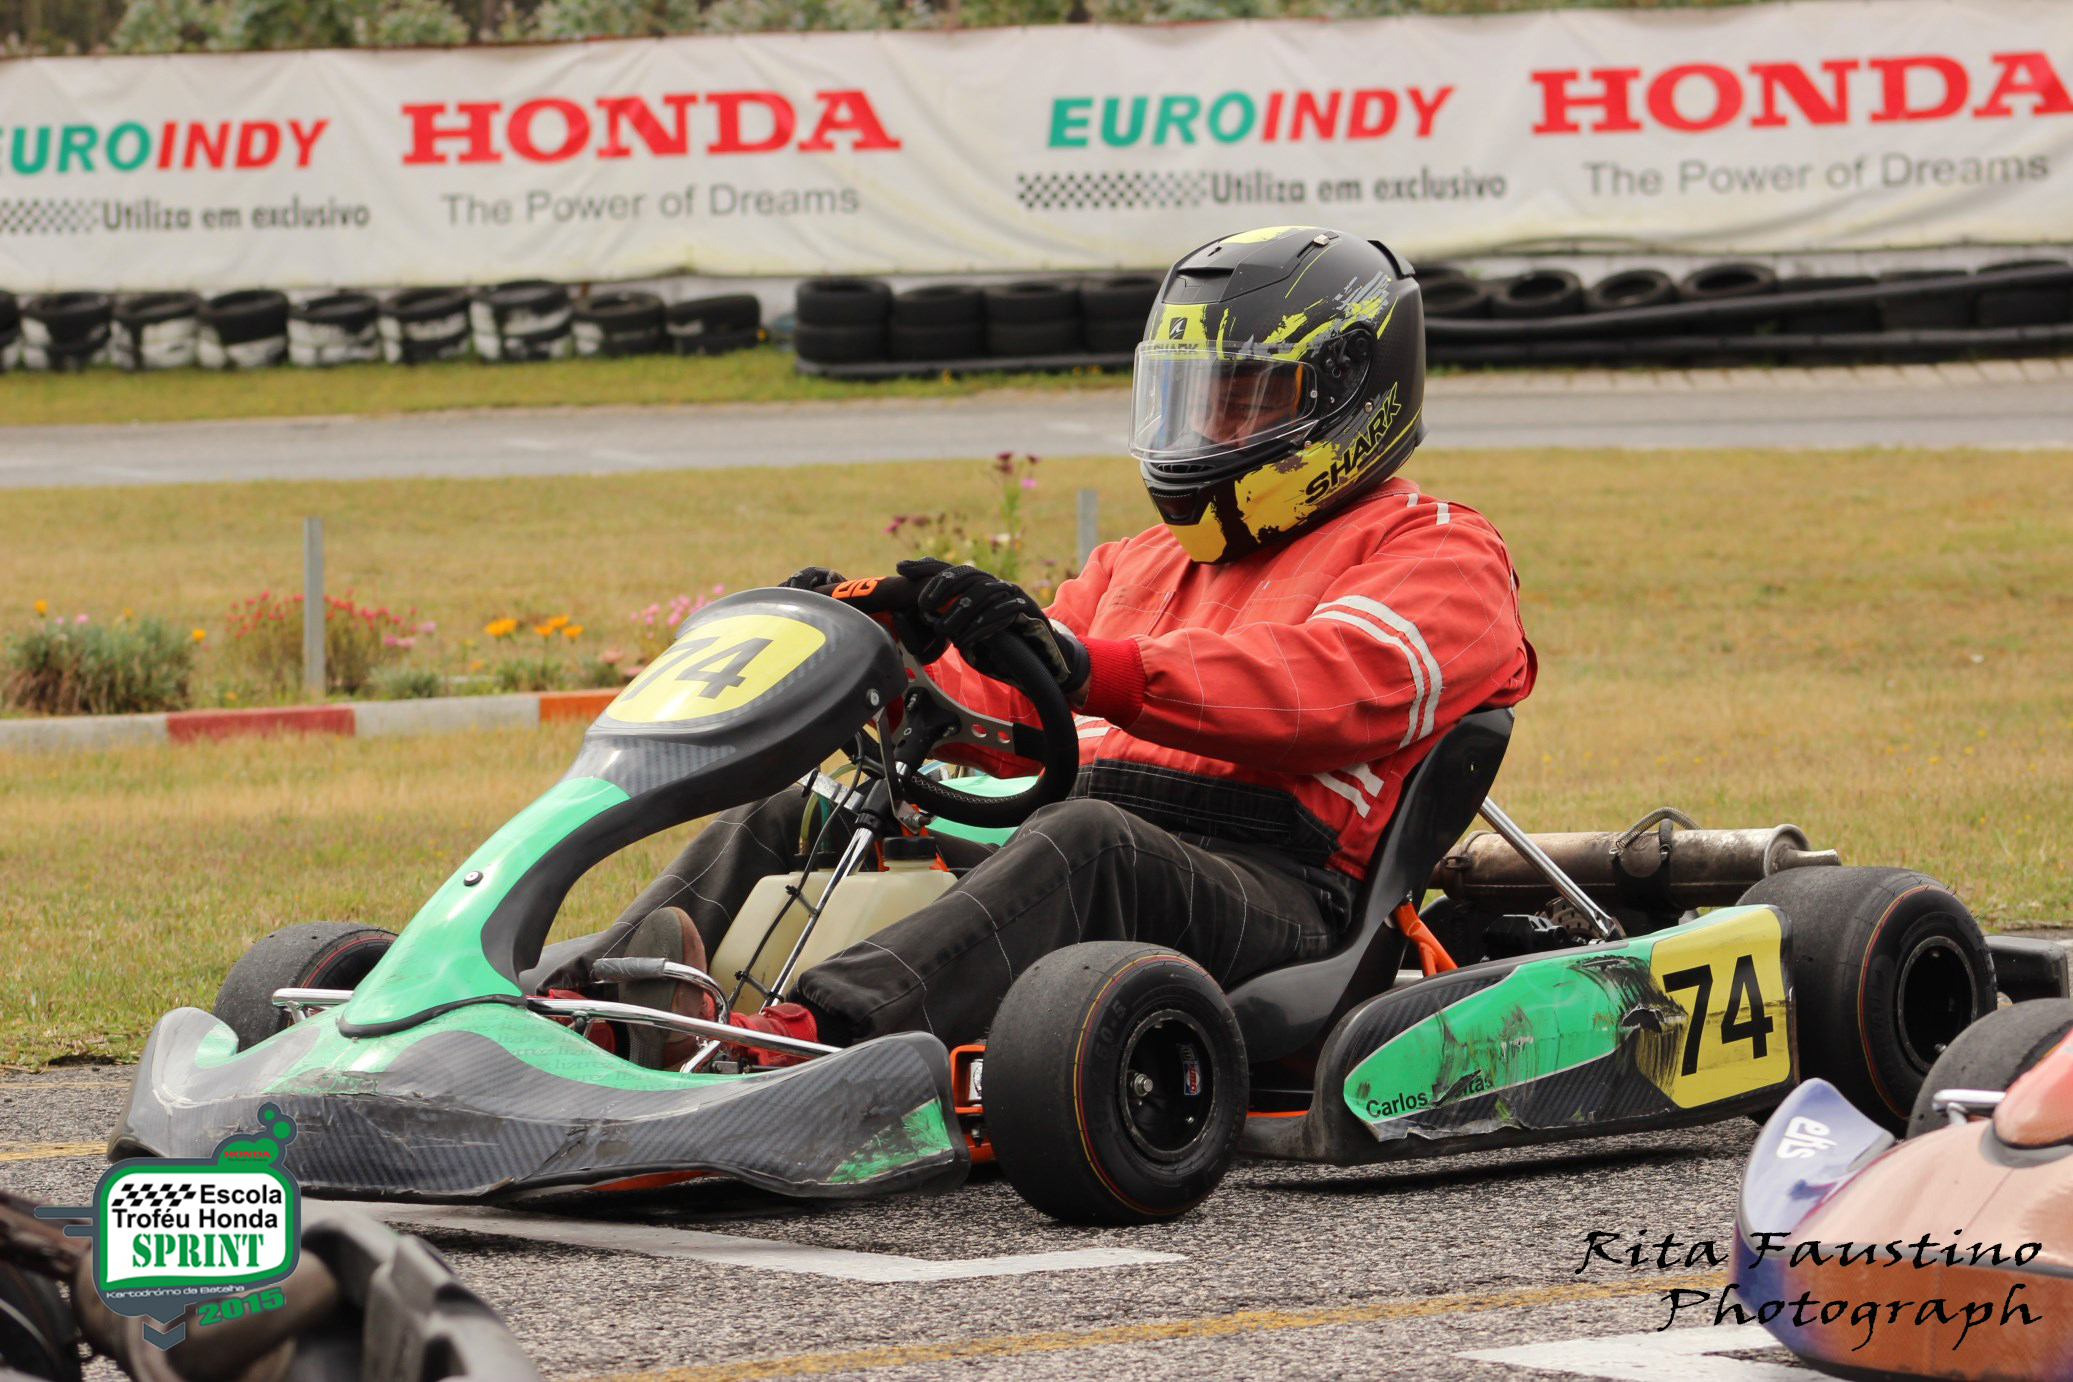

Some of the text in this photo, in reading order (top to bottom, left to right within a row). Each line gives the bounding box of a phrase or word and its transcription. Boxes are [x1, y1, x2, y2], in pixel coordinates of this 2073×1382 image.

[1048, 86, 1455, 149] EUROINDY
[1530, 50, 2073, 134] HONDA
[0, 119, 330, 174] UROINDY
[401, 89, 902, 164] HONDA
[1211, 165, 1507, 204] Utiliza em exclusivo
[1583, 151, 2050, 197] The Power of Dreams
[102, 194, 371, 232] Utiliza em exclusivo
[440, 184, 859, 227] The Power of Dreams
[1305, 381, 1402, 504] SHARK
[620, 636, 774, 700] 74
[1662, 954, 1775, 1078] 74
[1366, 1092, 1429, 1118] Carlos
